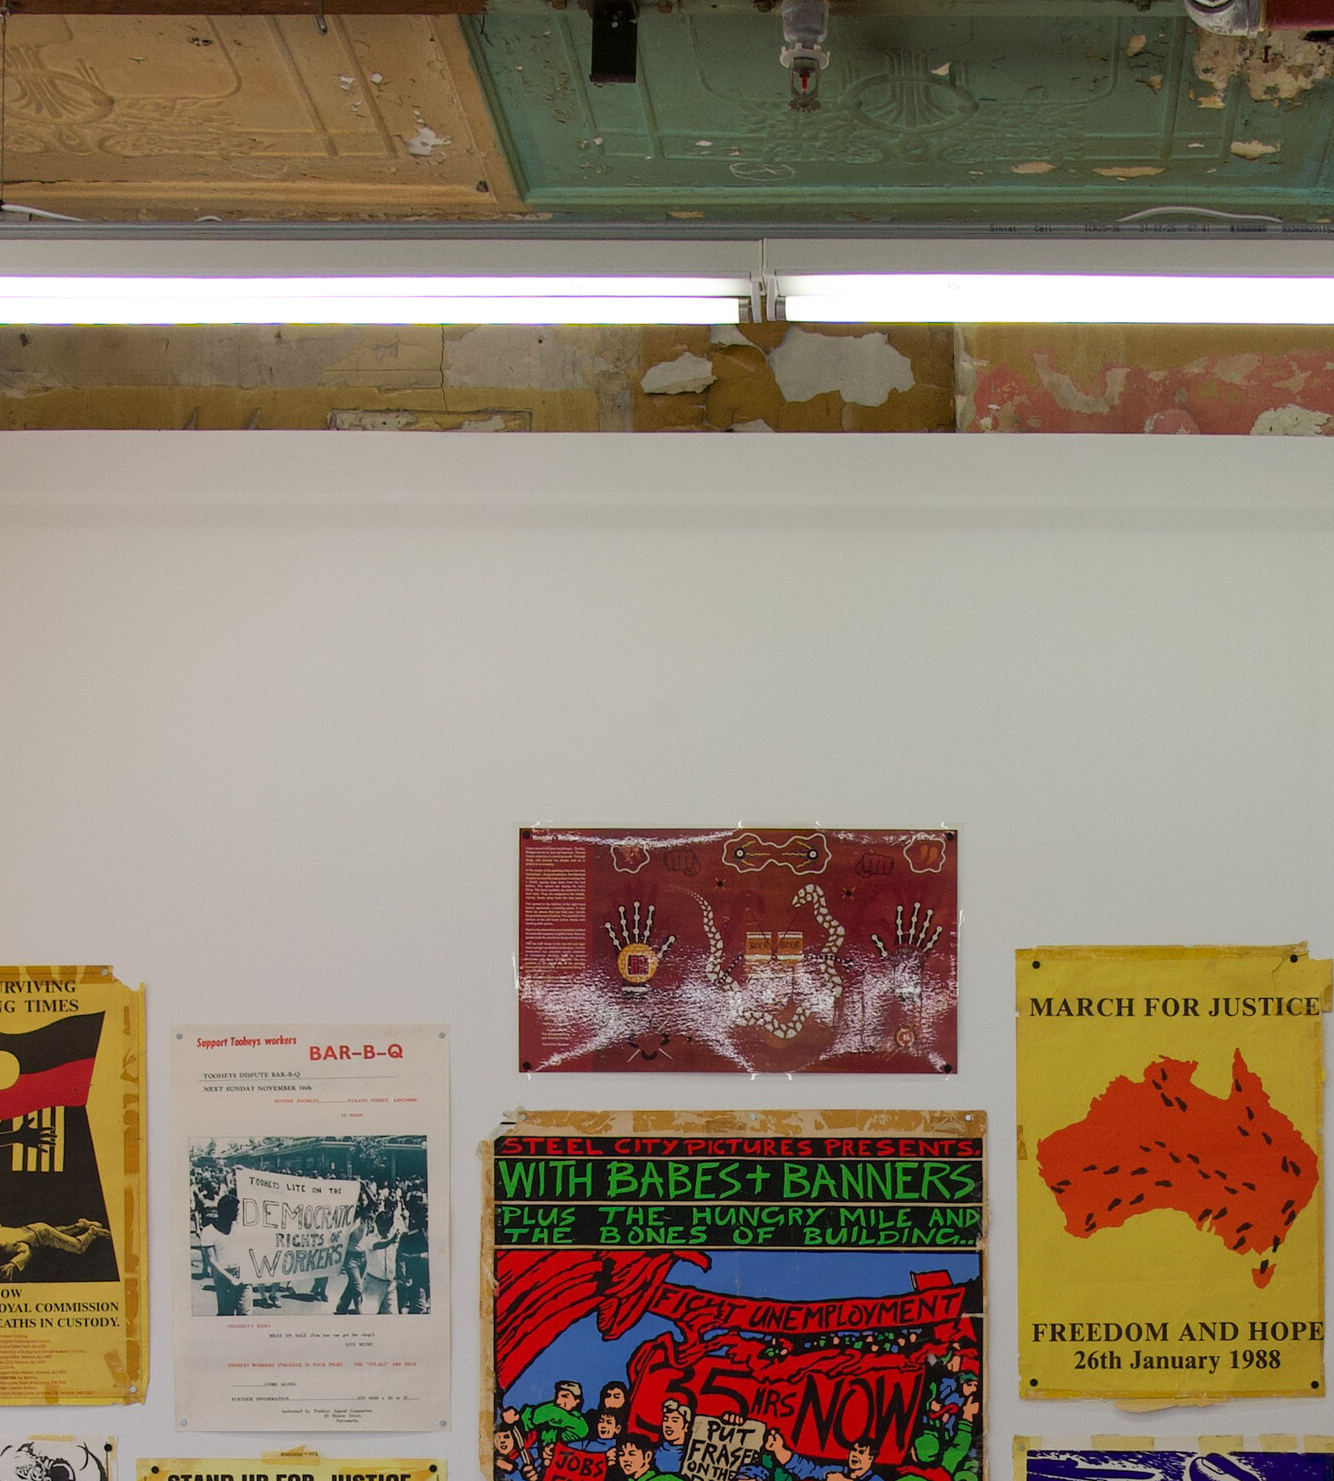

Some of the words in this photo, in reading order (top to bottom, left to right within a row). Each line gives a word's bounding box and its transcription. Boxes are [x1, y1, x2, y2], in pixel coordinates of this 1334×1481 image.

[24, 999, 79, 1013] TIMES
[1029, 997, 1134, 1017] MARCH
[1144, 997, 1199, 1017] FOR
[1208, 997, 1321, 1017] JUSTICE
[196, 1037, 228, 1049] Support
[230, 1036, 261, 1048] Tooheys
[265, 1035, 297, 1046] workers
[309, 1043, 404, 1061] BAR-B-Q
[501, 1138, 604, 1154] STEEL
[615, 1138, 676, 1157] CITY
[685, 1138, 813, 1156] PICTURES
[496, 1160, 594, 1200] WITH
[782, 1160, 976, 1200] BANNERS
[242, 1197, 357, 1230] DEMOCRATIC
[249, 1244, 344, 1278] WORKERS
[35, 1302, 119, 1312] COMMISSION
[749, 1291, 962, 1330] UNEMPLOYMENT
[1032, 1322, 1169, 1342] FREEDOM
[1177, 1322, 1239, 1342] AND
[1248, 1321, 1326, 1341] HOPE
[1074, 1351, 1122, 1370] 26th
[1130, 1350, 1220, 1374] January
[1230, 1350, 1281, 1369] 1988
[629, 1360, 749, 1439] 35
[751, 1385, 796, 1421] HRS
[792, 1373, 925, 1453] NOW
